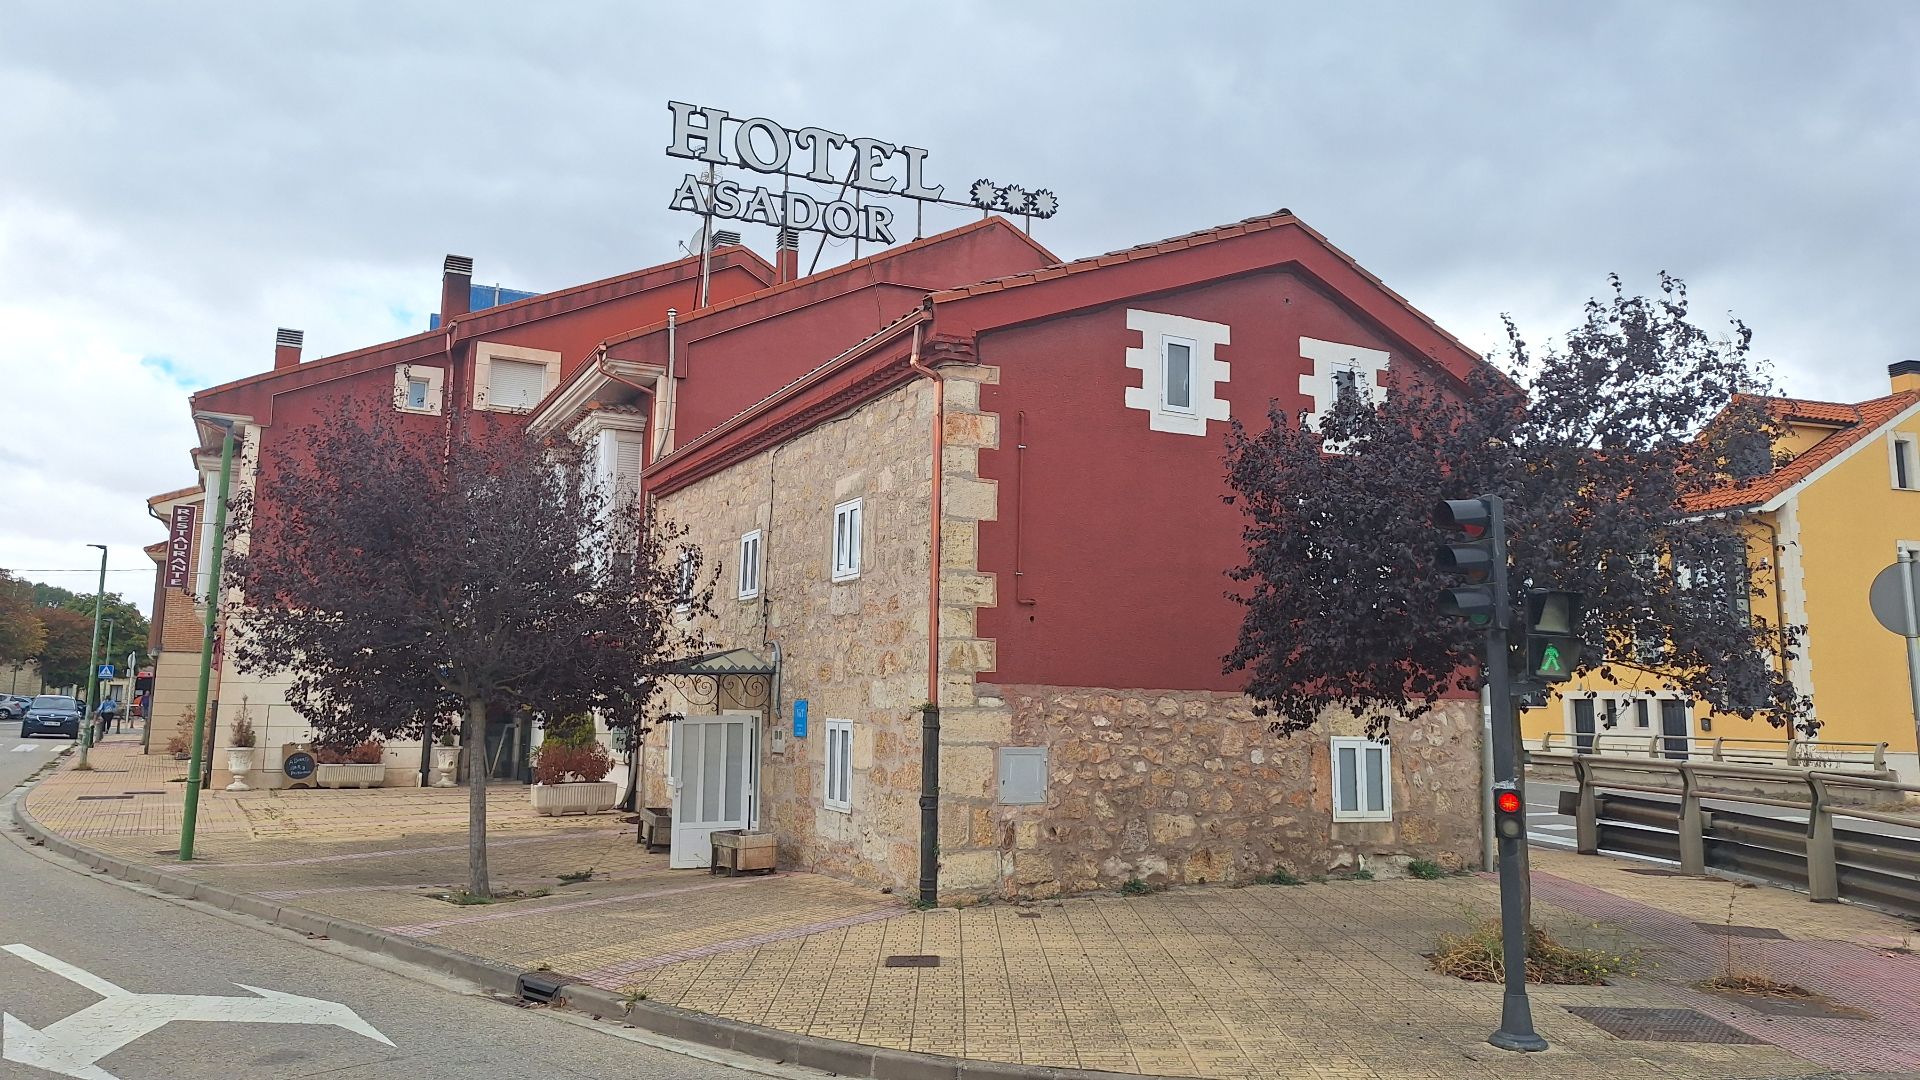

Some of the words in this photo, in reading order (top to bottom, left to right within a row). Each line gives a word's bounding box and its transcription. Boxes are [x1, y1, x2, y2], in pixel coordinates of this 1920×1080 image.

[666, 100, 944, 201] HOTEL
[668, 173, 897, 245] ASADOR
[170, 508, 190, 586] RESTAURANTE
